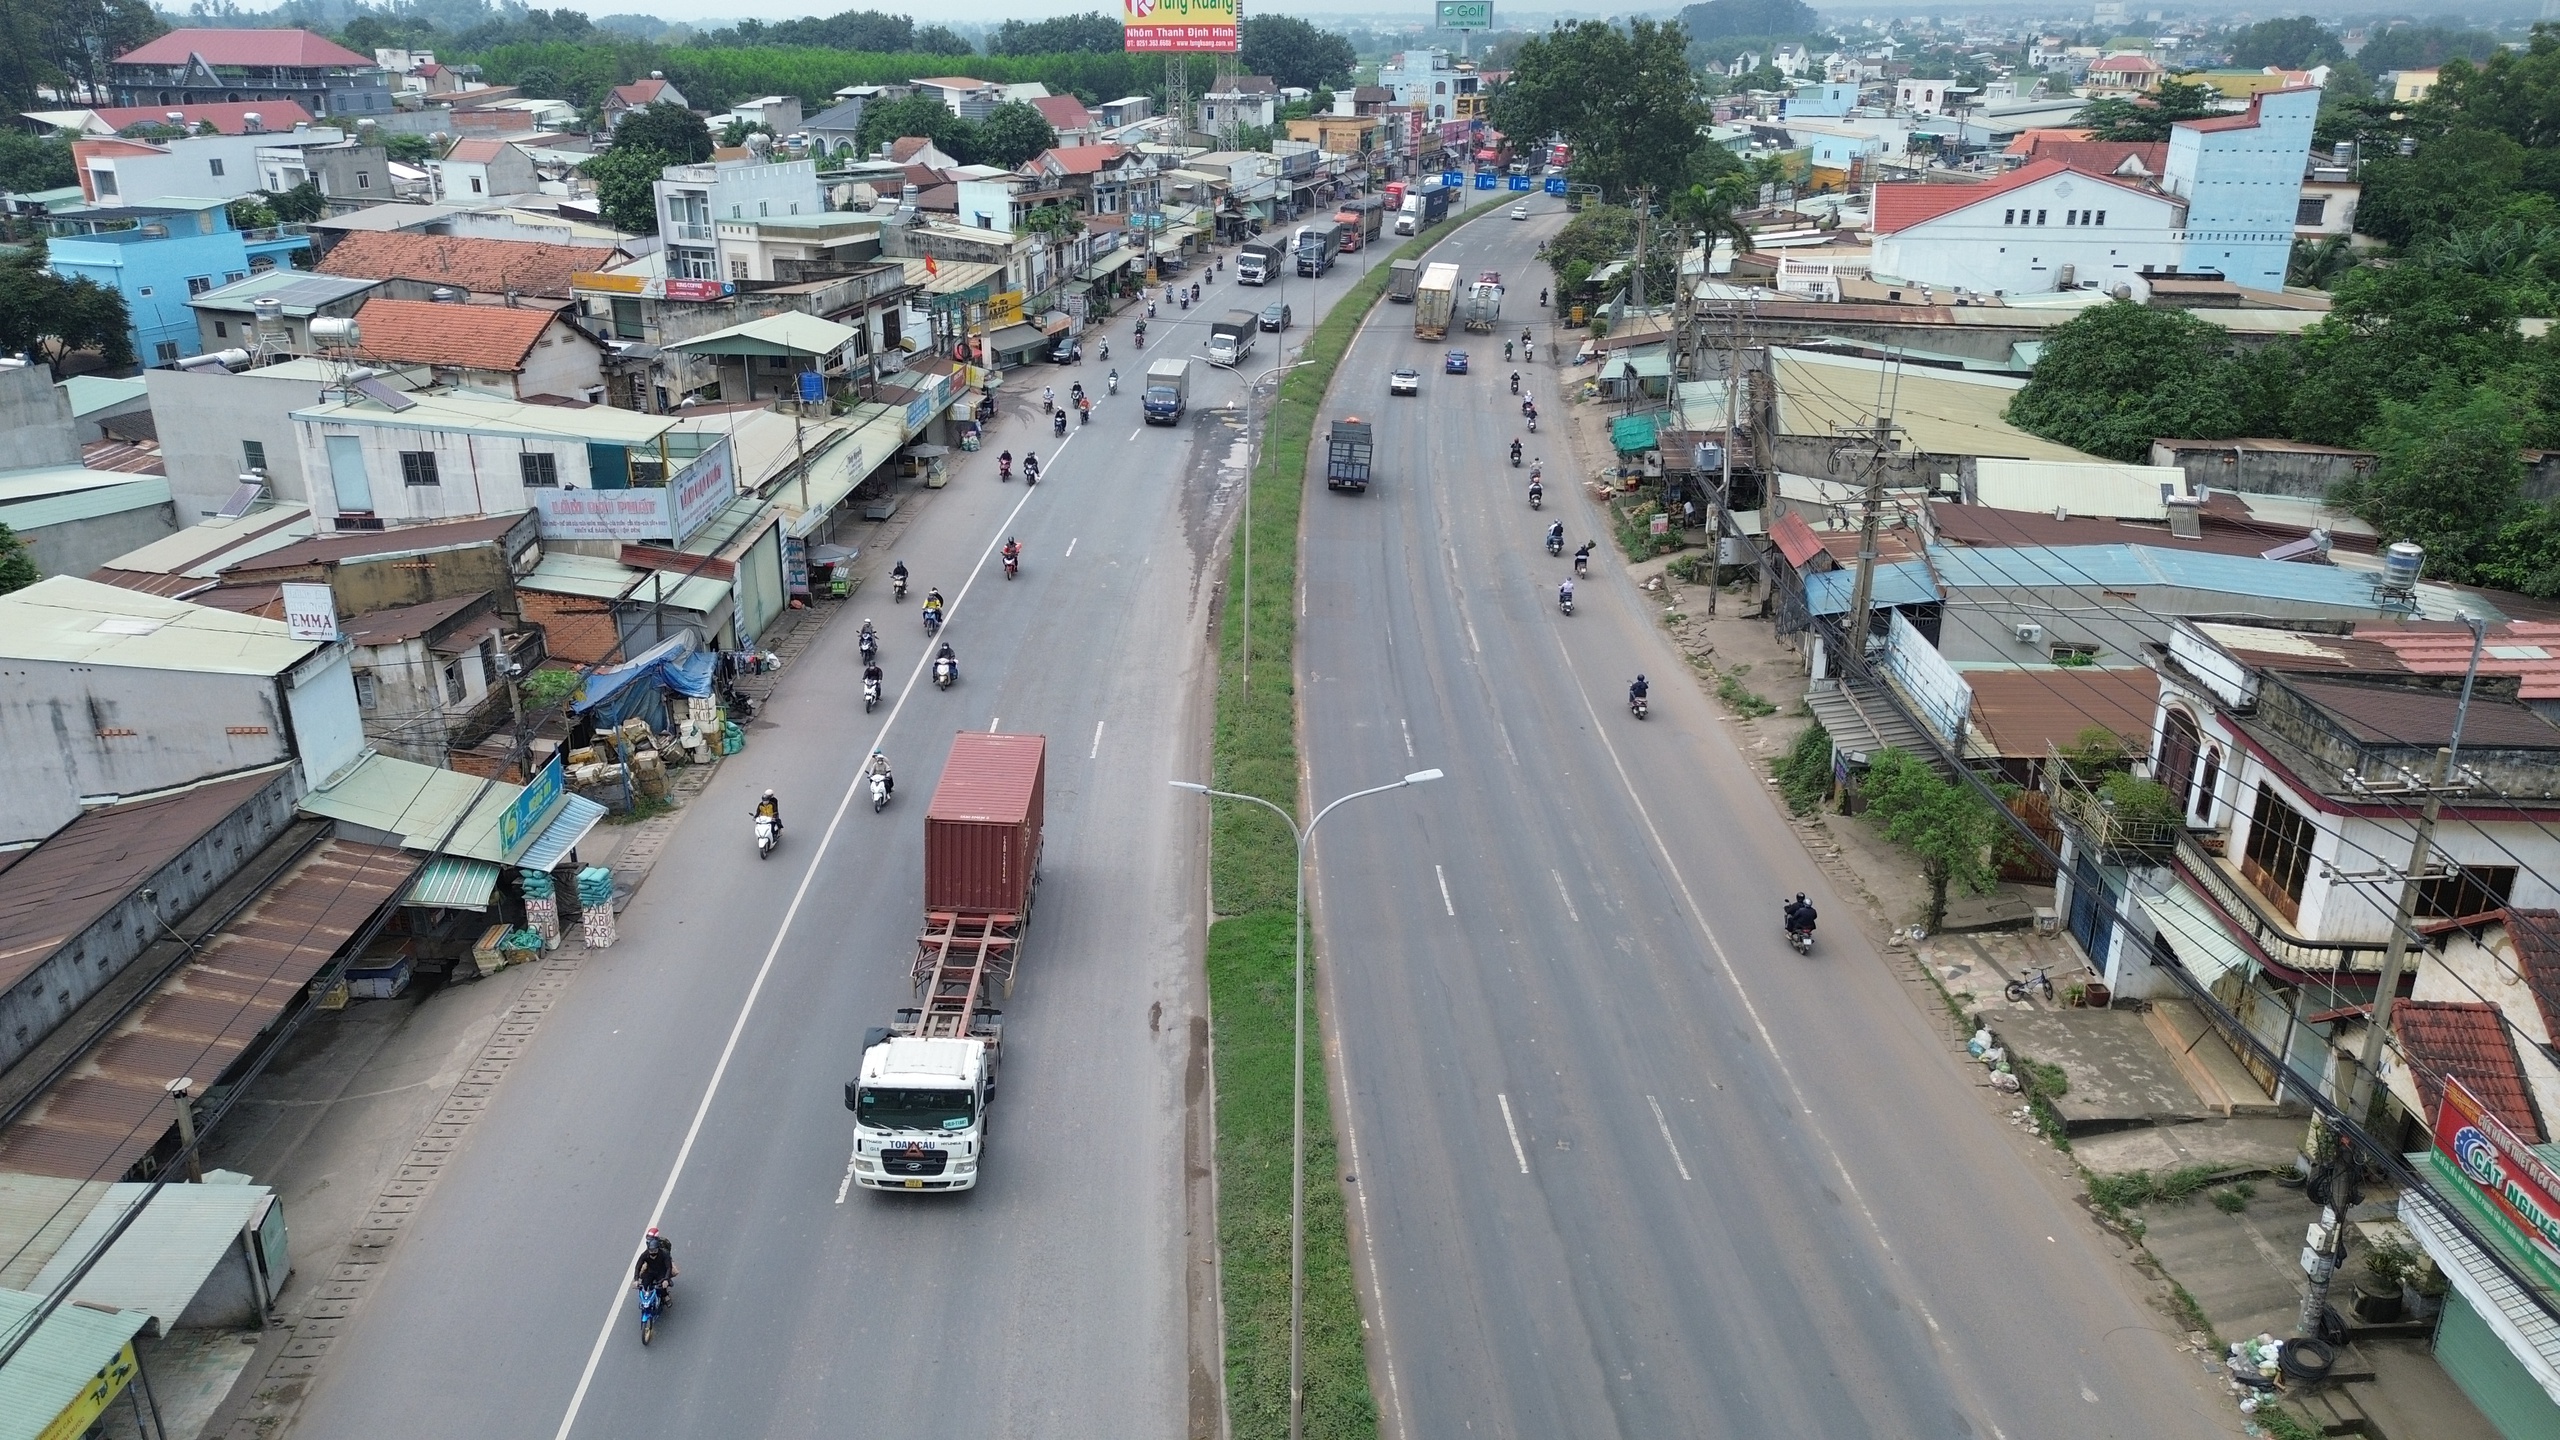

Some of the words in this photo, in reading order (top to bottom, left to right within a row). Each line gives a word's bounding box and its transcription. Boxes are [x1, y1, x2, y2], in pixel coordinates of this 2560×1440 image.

[1457, 5, 1484, 17] Golf
[1126, 28, 1153, 37] Nhôm
[1156, 28, 1184, 37] Thanh
[1187, 28, 1209, 38] Định
[1212, 28, 1234, 37] Hình
[290, 613, 332, 628] EMMA
[2478, 1114, 2492, 1135] CỬA
[2491, 1129, 2512, 1154] HÀNG
[2511, 1143, 2531, 1171] THIẾT
[2529, 1162, 2540, 1182] BỊ
[2473, 1150, 2502, 1188] CÁT
[2505, 1181, 2560, 1247] NGUYÊ
